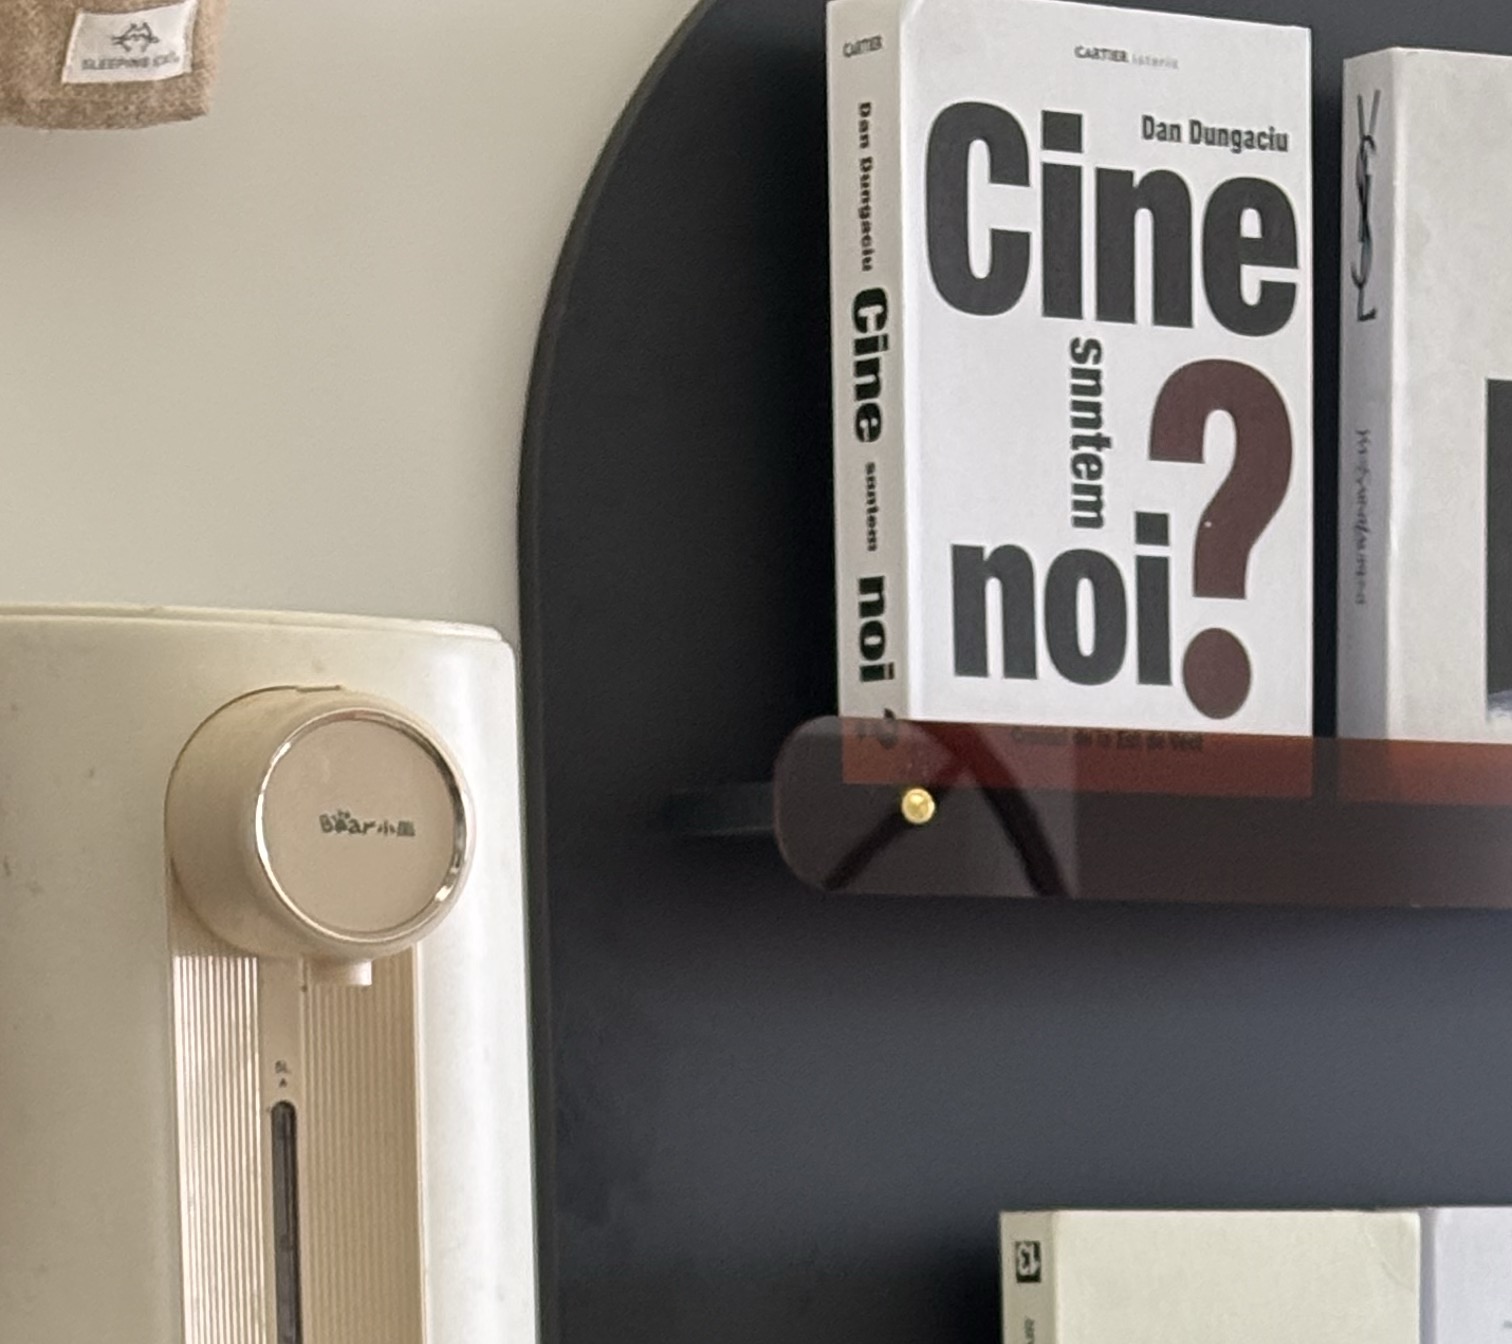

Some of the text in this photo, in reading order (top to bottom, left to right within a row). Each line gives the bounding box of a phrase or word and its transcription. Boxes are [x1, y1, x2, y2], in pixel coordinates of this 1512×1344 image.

[1075, 46, 1129, 63] CARTIER
[858, 102, 872, 149] Dan
[1142, 114, 1289, 154] Dan Dungaciu
[858, 156, 875, 271] Dungaciu
[926, 101, 1299, 337] Cine
[853, 287, 889, 442] Cine
[858, 575, 894, 682] noi
